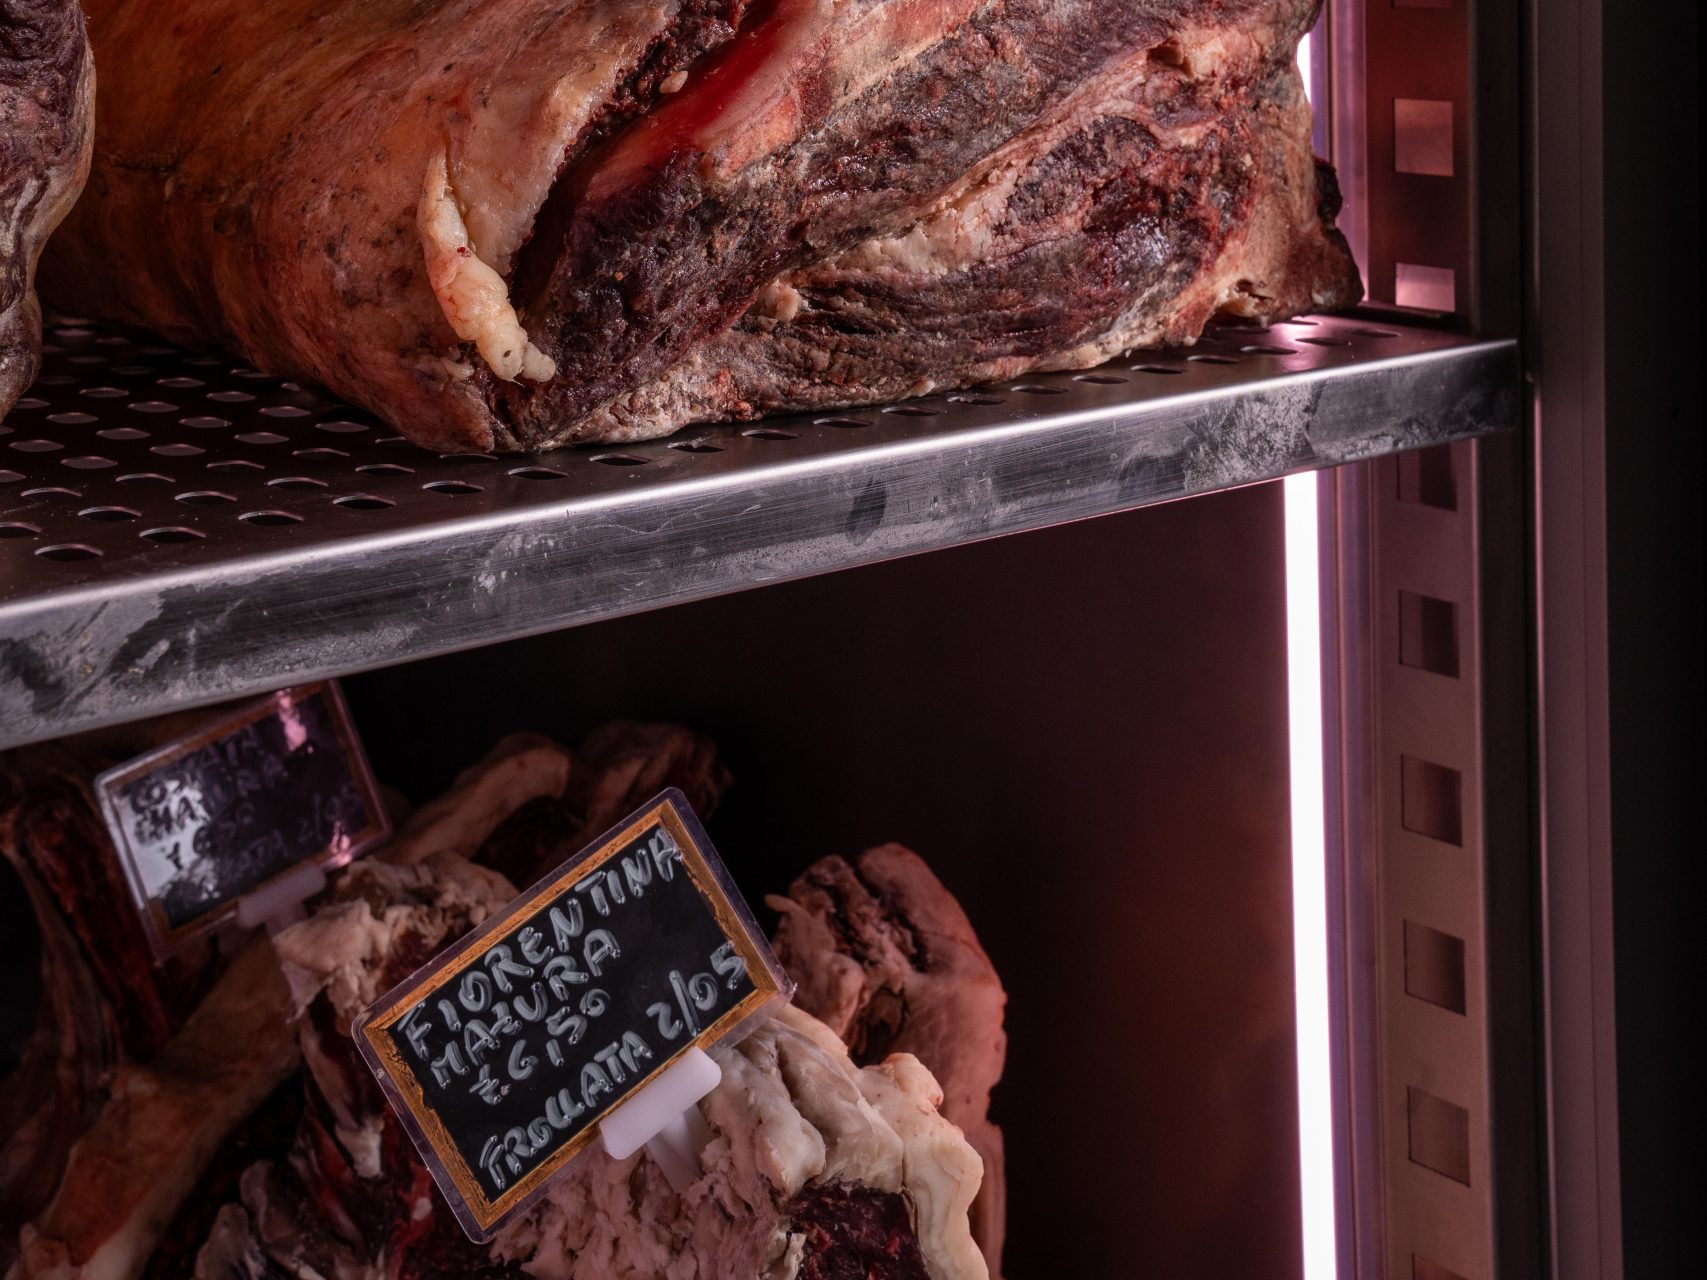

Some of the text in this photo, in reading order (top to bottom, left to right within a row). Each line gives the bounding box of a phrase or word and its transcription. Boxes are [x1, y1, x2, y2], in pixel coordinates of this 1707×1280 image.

[397, 827, 685, 1060] FIORENTINA
[479, 941, 748, 1190] FROLLATA 2/05
